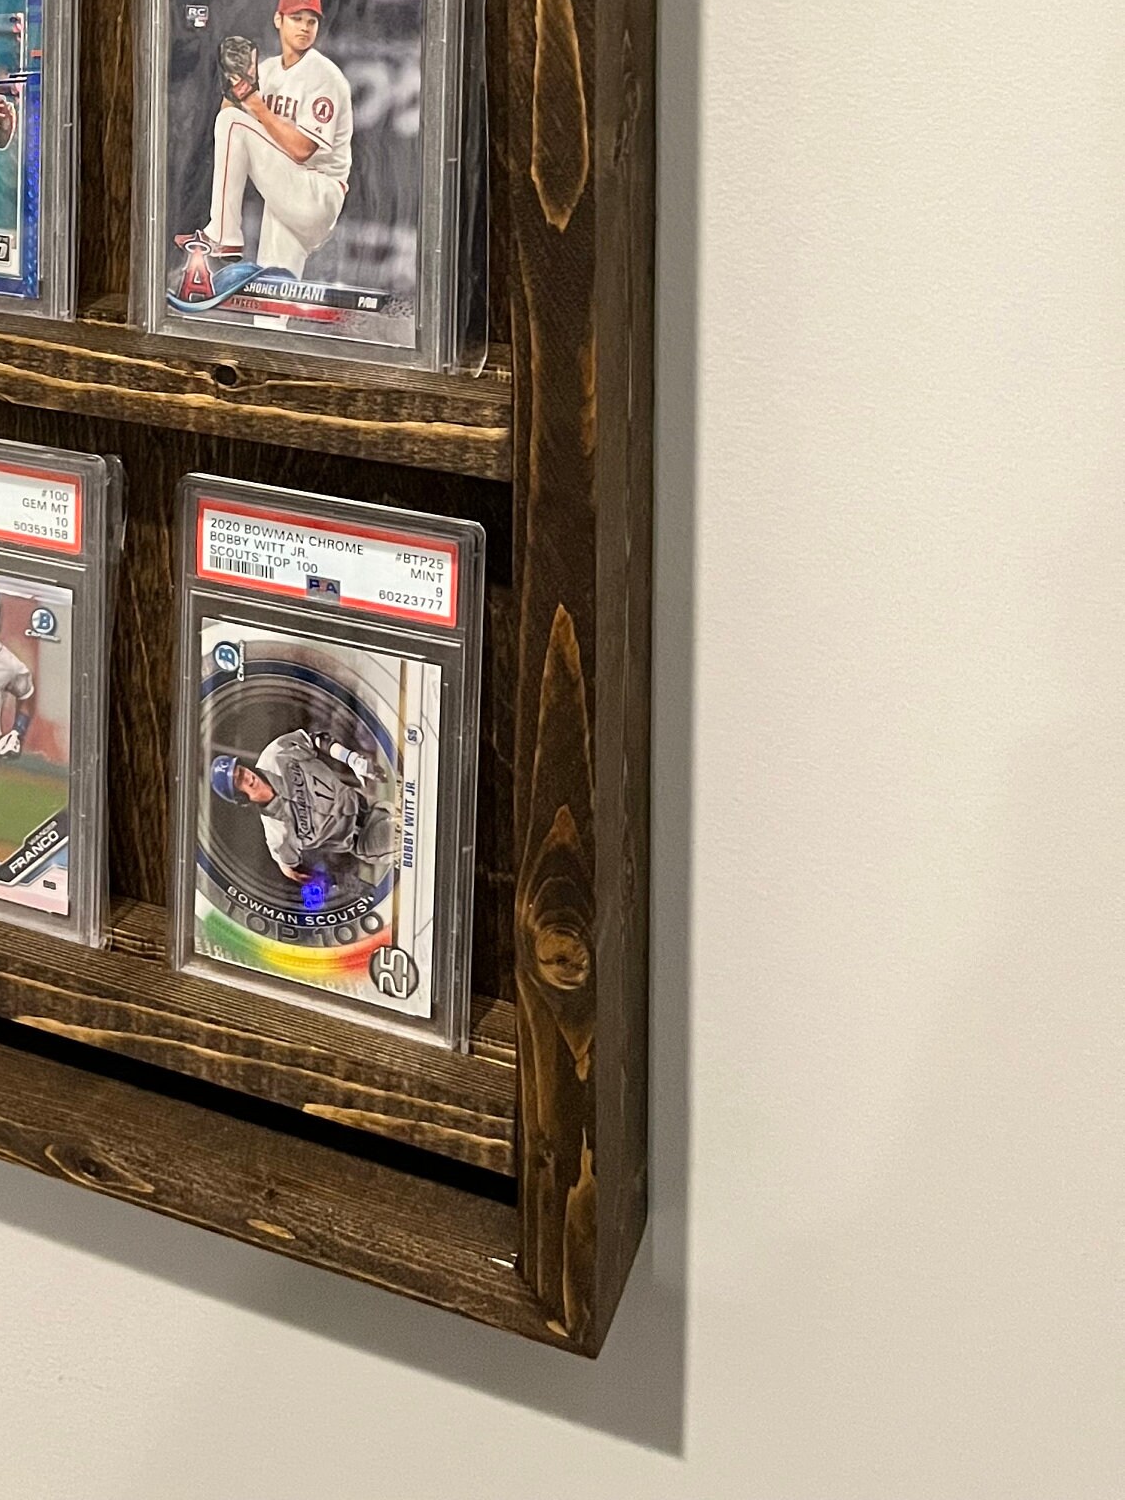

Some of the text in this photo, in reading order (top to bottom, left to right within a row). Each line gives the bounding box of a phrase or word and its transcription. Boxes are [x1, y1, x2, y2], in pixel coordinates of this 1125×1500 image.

[188, 8, 206, 16] RC
[280, 283, 325, 302] OHTANI
[42, 489, 69, 502] #100
[22, 498, 68, 515] GEM MT
[14, 521, 68, 540] 50353158
[56, 516, 67, 527] 10
[210, 531, 308, 558] BOBBY WITT JR.
[211, 518, 364, 556] 2020 BOWMAN CHROME
[266, 554, 291, 568] TOP
[297, 560, 317, 574] 100
[395, 552, 443, 570] #BTP25
[411, 568, 443, 584] MINT
[379, 590, 443, 611] 60223777
[435, 587, 443, 598] 9
[405, 799, 415, 826] WITT
[9, 830, 60, 874] FRANCO
[403, 830, 414, 868] BOBBY
[227, 886, 298, 925] BOWMAN
[227, 899, 384, 947] TOP 100
[378, 947, 408, 999] 25
